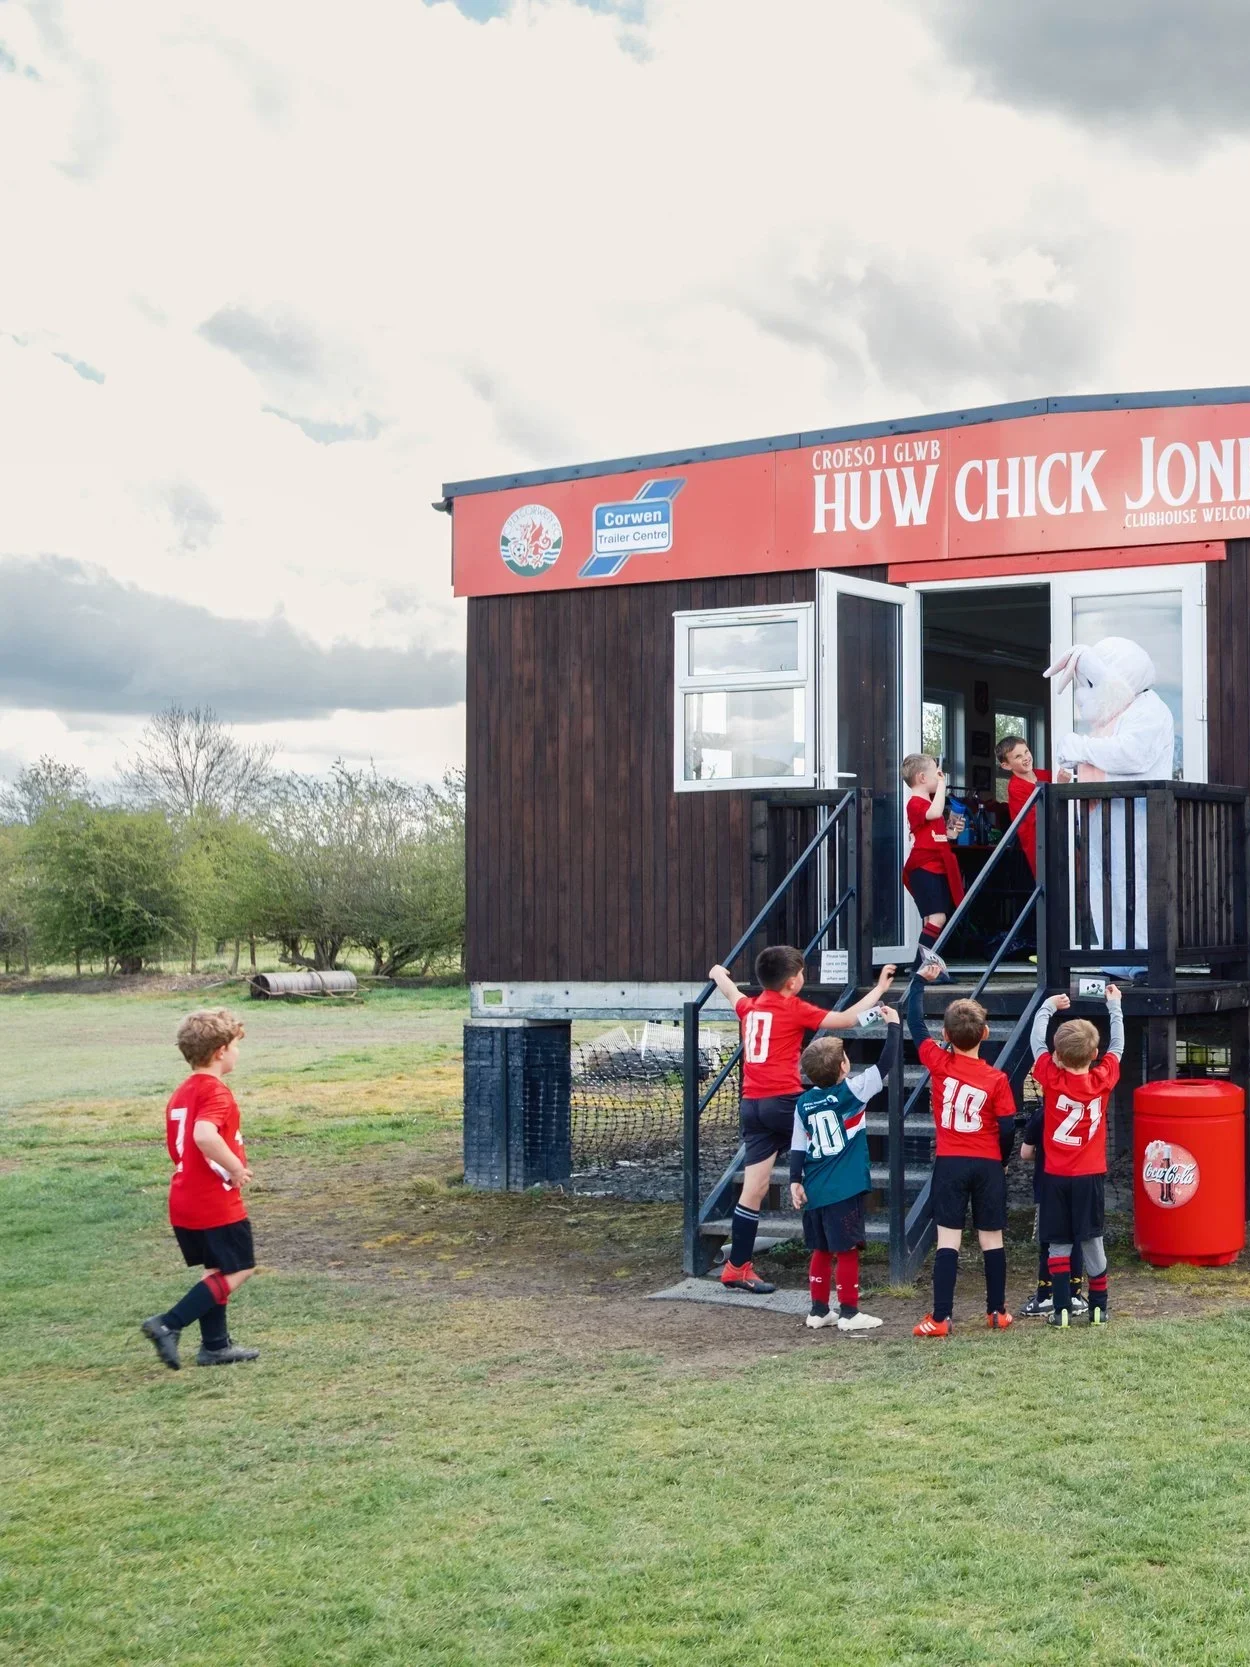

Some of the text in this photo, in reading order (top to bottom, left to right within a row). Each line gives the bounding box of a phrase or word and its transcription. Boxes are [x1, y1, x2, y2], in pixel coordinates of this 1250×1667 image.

[812, 439, 941, 471] CROESO I GLWB
[812, 463, 940, 534] HUW
[954, 449, 1108, 522] CHICK
[598, 530, 668, 545] Trailer Centre
[604, 510, 662, 527] Corwen
[1125, 507, 1197, 529] CLUBHOUSE
[941, 1076, 988, 1133] 10
[1052, 1093, 1103, 1146] 21
[170, 1107, 188, 1173] 7
[807, 1109, 845, 1159] 10
[1143, 1162, 1197, 1184] Coca-Cola
